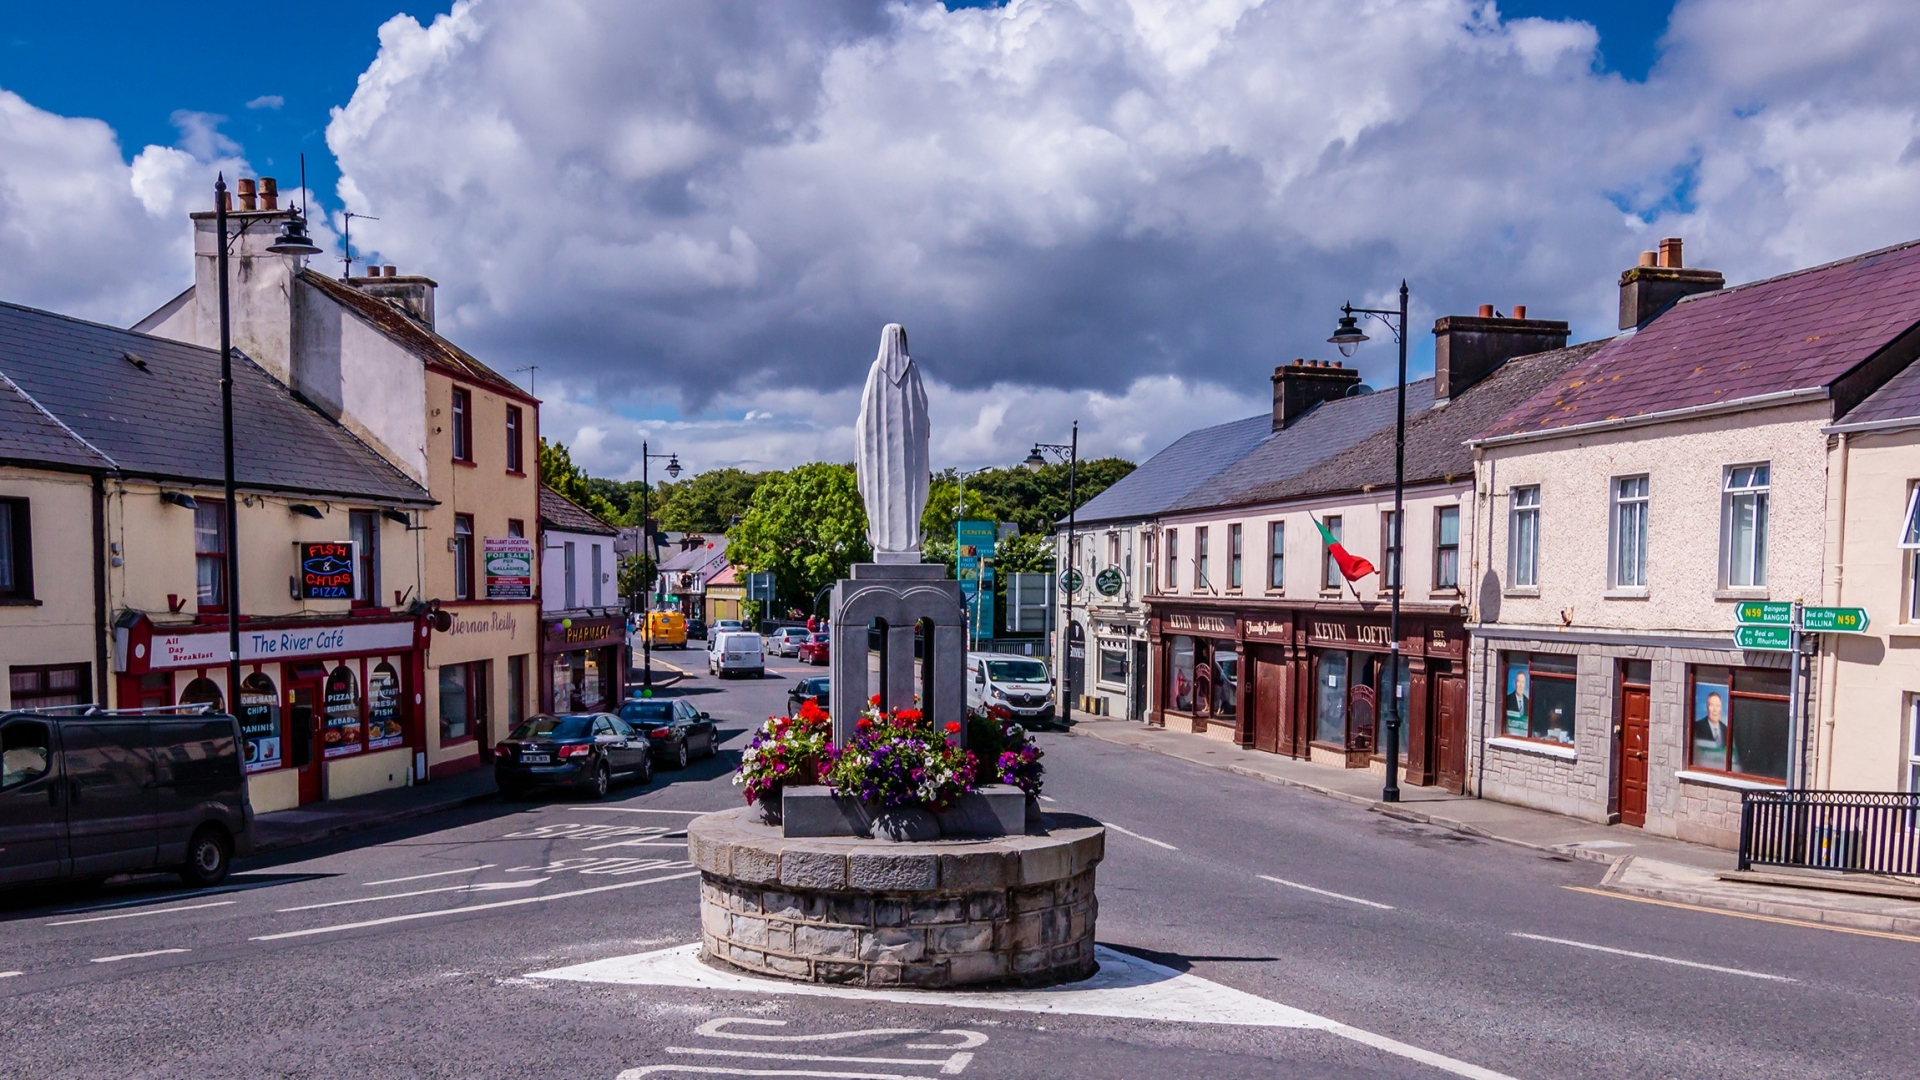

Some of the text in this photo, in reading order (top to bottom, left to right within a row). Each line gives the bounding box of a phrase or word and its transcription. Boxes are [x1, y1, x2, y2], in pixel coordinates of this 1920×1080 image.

[309, 544, 346, 557] FISH
[323, 562, 331, 571] &
[306, 574, 350, 586] CHIPS
[312, 587, 347, 597] PIZZA
[1745, 608, 1762, 617] N59
[1170, 614, 1225, 632] KEVIN LOFTUS
[1838, 615, 1856, 625] N59
[450, 611, 516, 640] Tiernan Reilly
[566, 626, 610, 643] PHARMACY
[1314, 622, 1393, 645] KEVIN LOFTU
[252, 629, 343, 653] The River Café
[173, 652, 213, 661] Breakfast
[241, 695, 277, 704] OME-MADE
[328, 693, 355, 702] PIZZAS
[327, 704, 356, 713] BURGERS
[370, 699, 396, 708] FRESH
[247, 706, 268, 715] CHIPS
[374, 708, 393, 716] FISH
[328, 717, 356, 726] KEBABS
[502, 824, 670, 840] STOP
[505, 858, 695, 875] STOP
